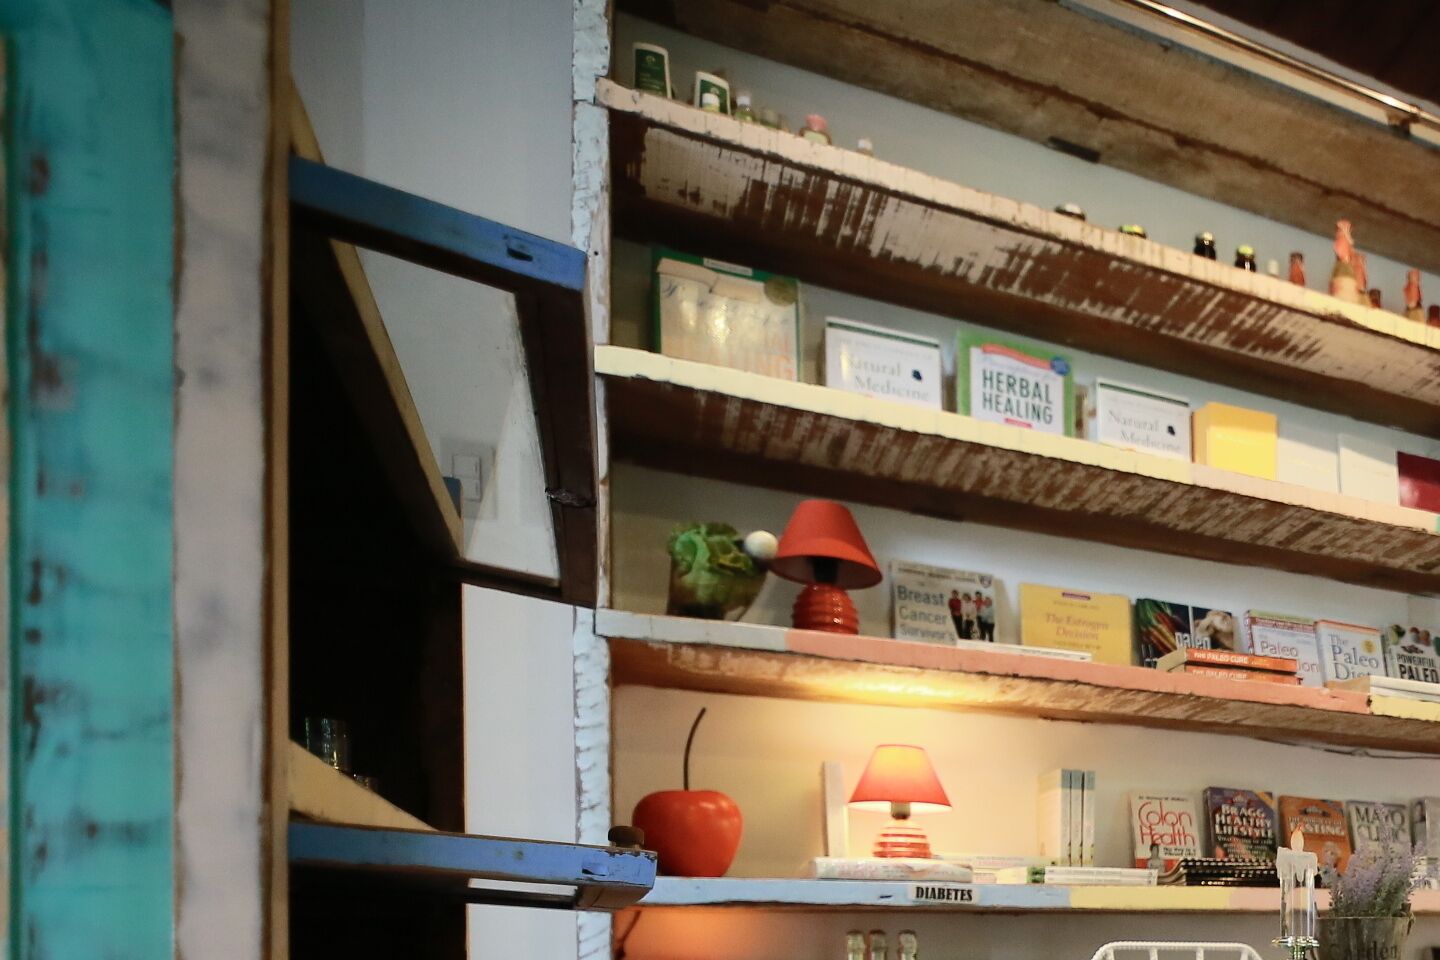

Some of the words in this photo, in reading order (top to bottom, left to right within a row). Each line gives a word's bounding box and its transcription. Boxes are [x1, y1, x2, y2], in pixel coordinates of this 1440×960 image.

[981, 368, 1053, 405] HERBAL
[982, 391, 1054, 425] HEALING
[1107, 409, 1160, 433] Natural
[1119, 430, 1182, 453] Medicine
[896, 585, 945, 606] Breast
[899, 605, 948, 625] Cancer
[1207, 652, 1230, 663] PALEO
[1230, 655, 1249, 665] CURE
[1260, 640, 1299, 658] Paleo
[1331, 644, 1380, 669] Paleo
[1398, 664, 1440, 684] PALEO
[1138, 800, 1192, 828] Colon
[1215, 812, 1273, 828] HEALTHY
[1139, 823, 1196, 846] Health
[1214, 824, 1274, 839] LIFESTYLE
[1289, 821, 1345, 836] FSTING
[915, 886, 973, 902] DIABETES
